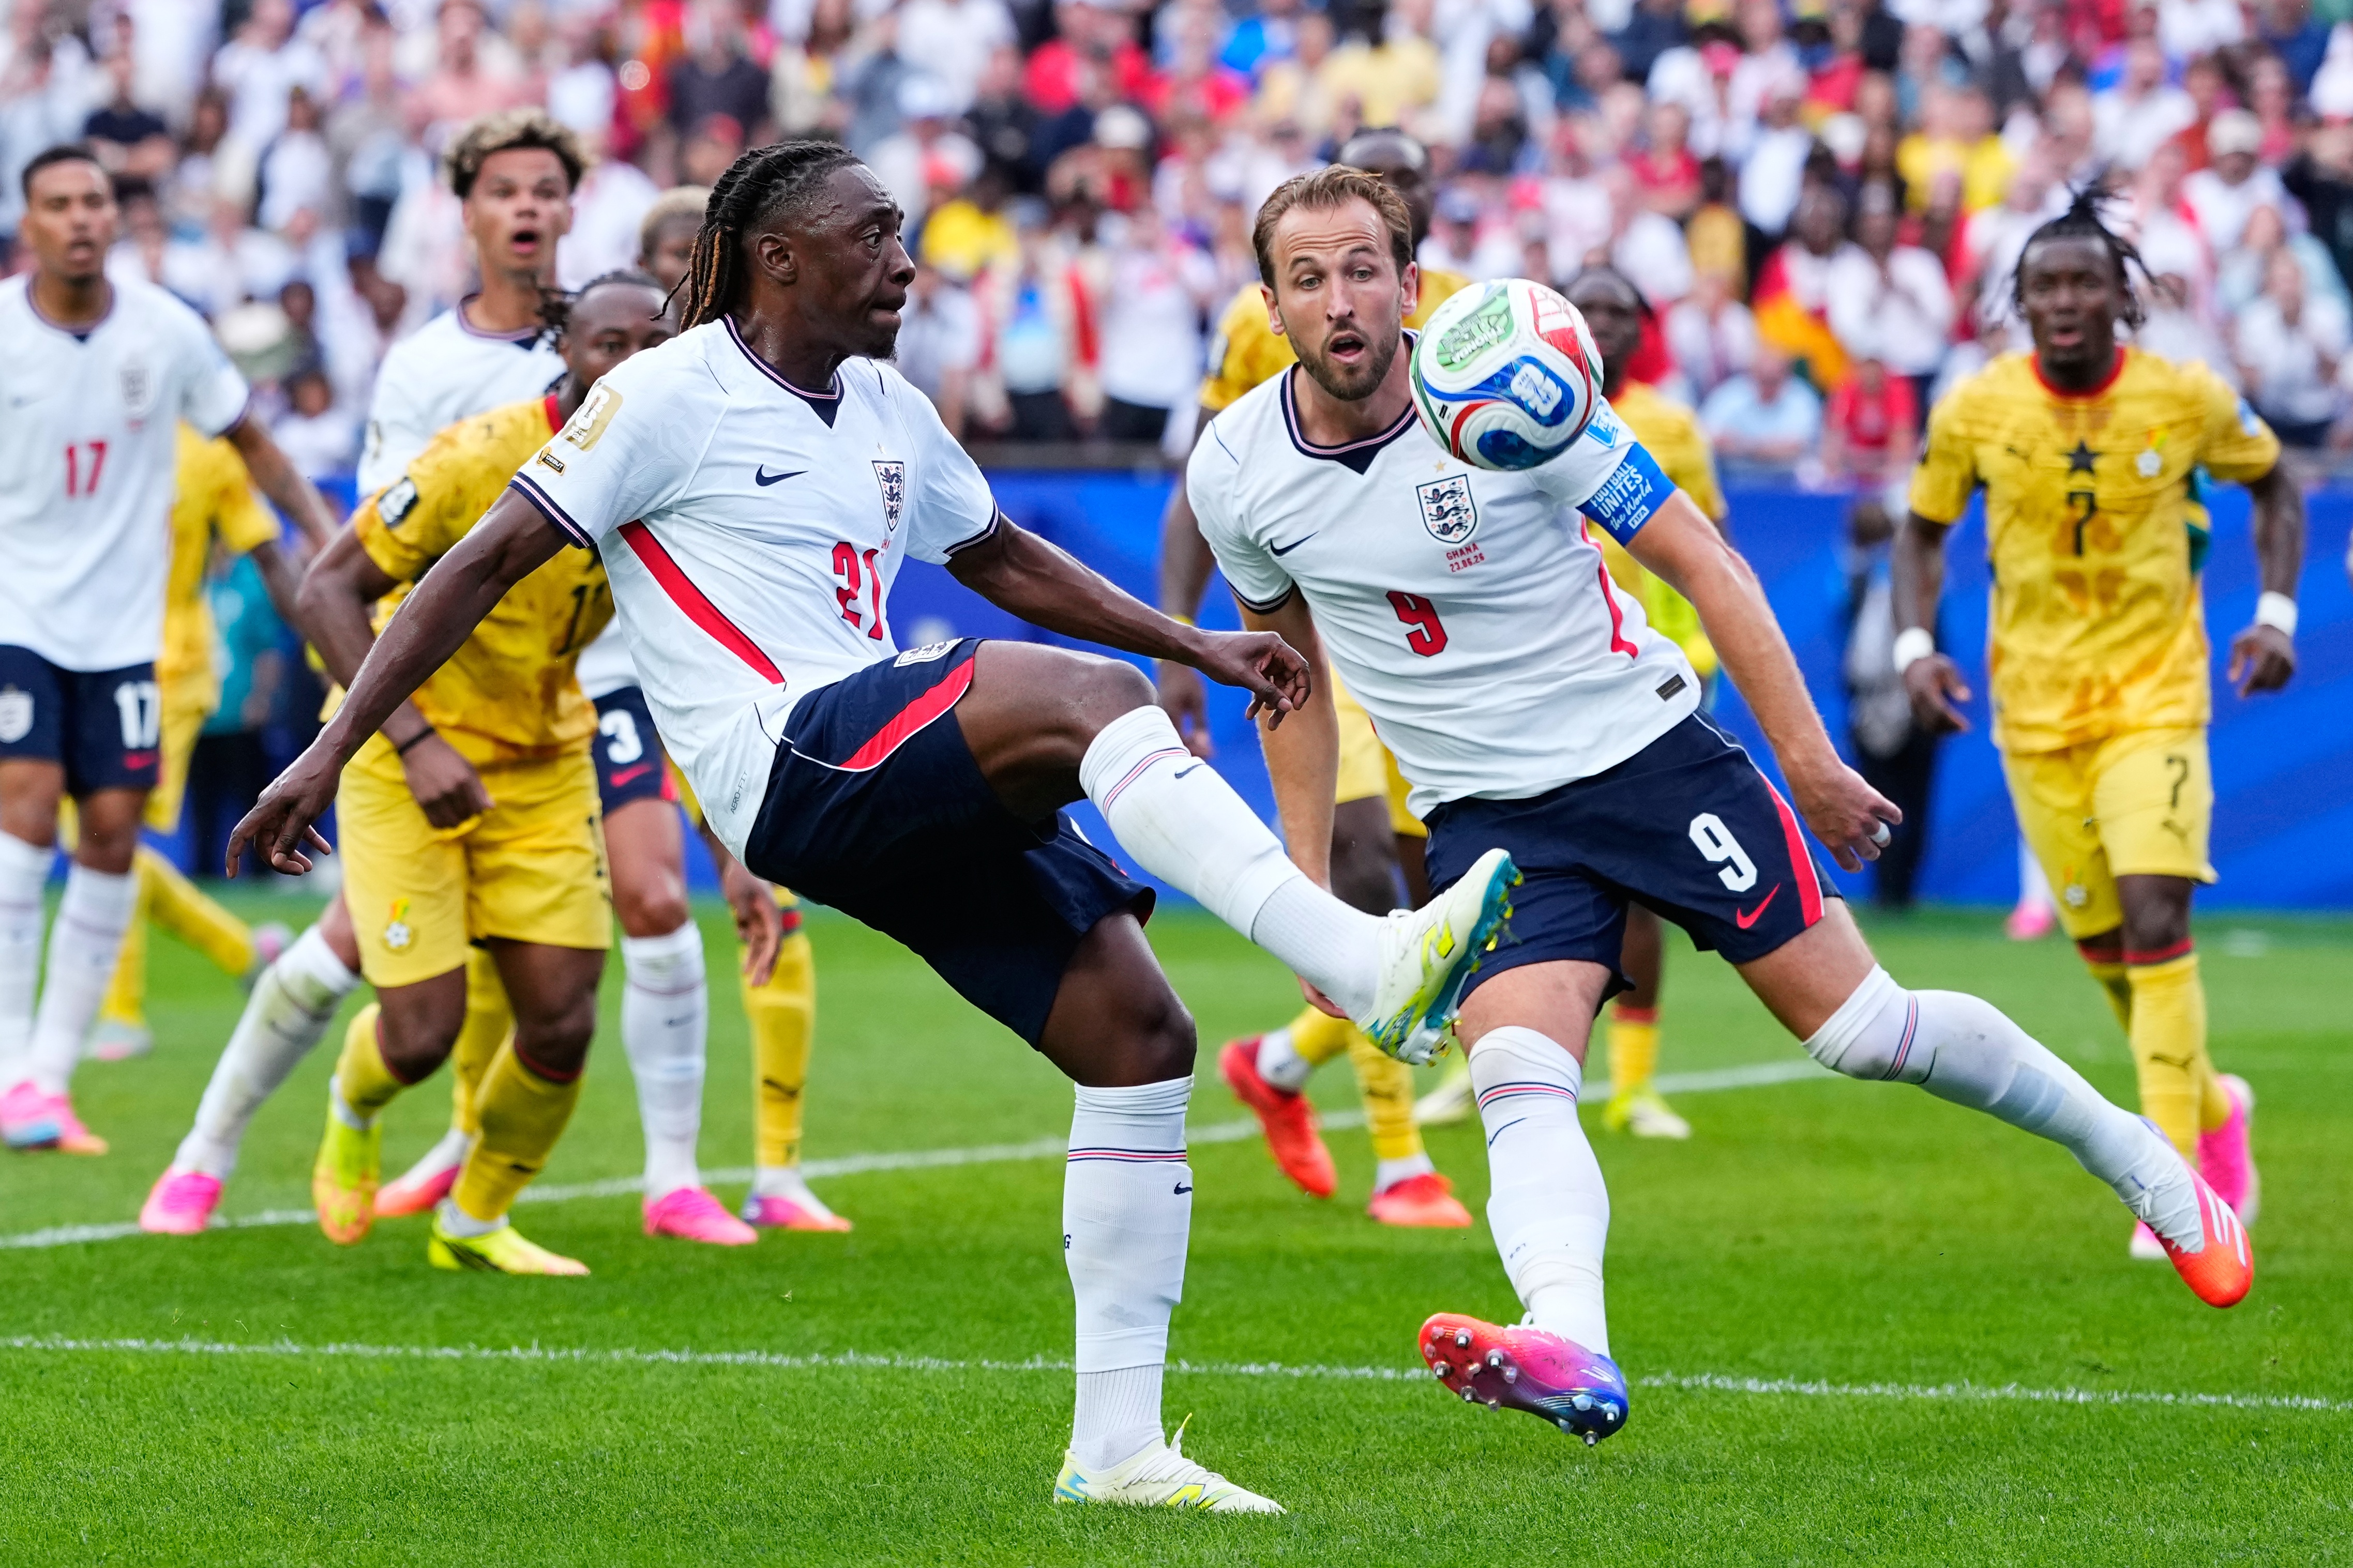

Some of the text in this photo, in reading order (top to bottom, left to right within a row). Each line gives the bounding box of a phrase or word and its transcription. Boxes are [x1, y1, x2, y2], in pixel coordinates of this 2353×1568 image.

[66, 442, 107, 496] 17
[546, 454, 564, 468] DEBUT
[1598, 467, 1643, 519] UNITES
[1610, 478, 1653, 531] the World
[1630, 508, 1648, 527] FIFA
[2067, 491, 2098, 558] 7
[1445, 542, 1479, 561] GHANA
[1449, 552, 1485, 573] 23.06.26
[832, 541, 883, 641] 21
[1385, 590, 1448, 658] 9
[113, 680, 161, 750] 17
[598, 708, 643, 765] 3
[730, 769, 748, 815] AERO-FIT
[2165, 756, 2189, 809] 7
[1689, 812, 1758, 893] 9
